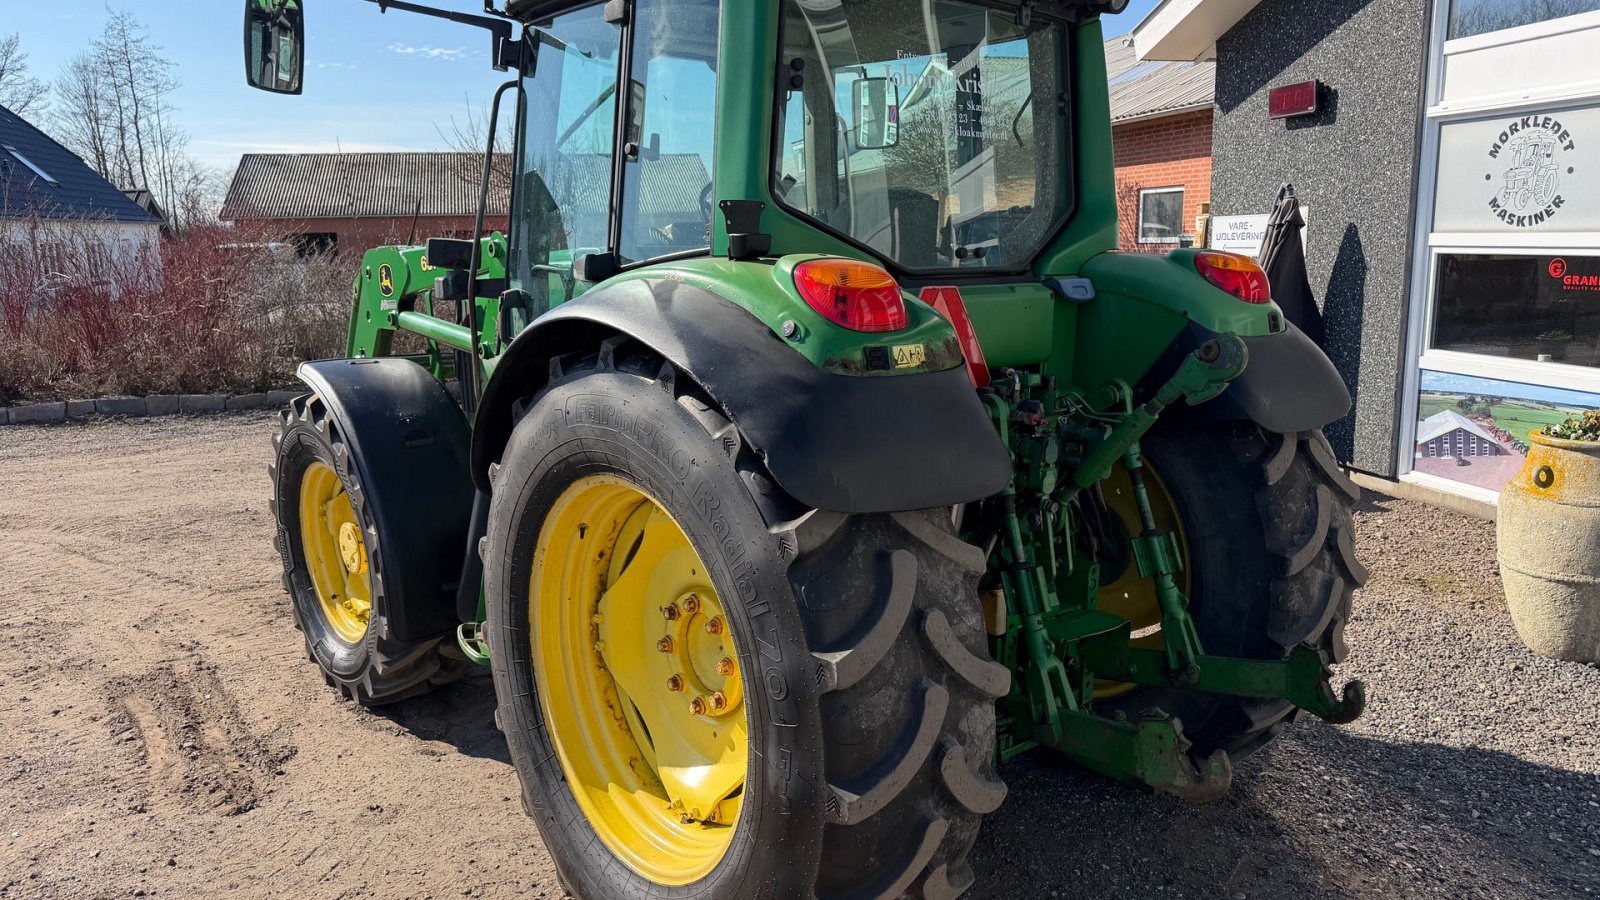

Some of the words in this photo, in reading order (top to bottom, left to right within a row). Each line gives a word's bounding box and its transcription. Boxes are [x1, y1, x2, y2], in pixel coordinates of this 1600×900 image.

[1488, 115, 1575, 160] MØRKLEDET
[1228, 221, 1253, 231] VARE-
[1488, 194, 1566, 228] MASKINER
[575, 396, 691, 481] FarmPRO
[692, 479, 771, 619] Radial
[755, 627, 790, 702] 70
